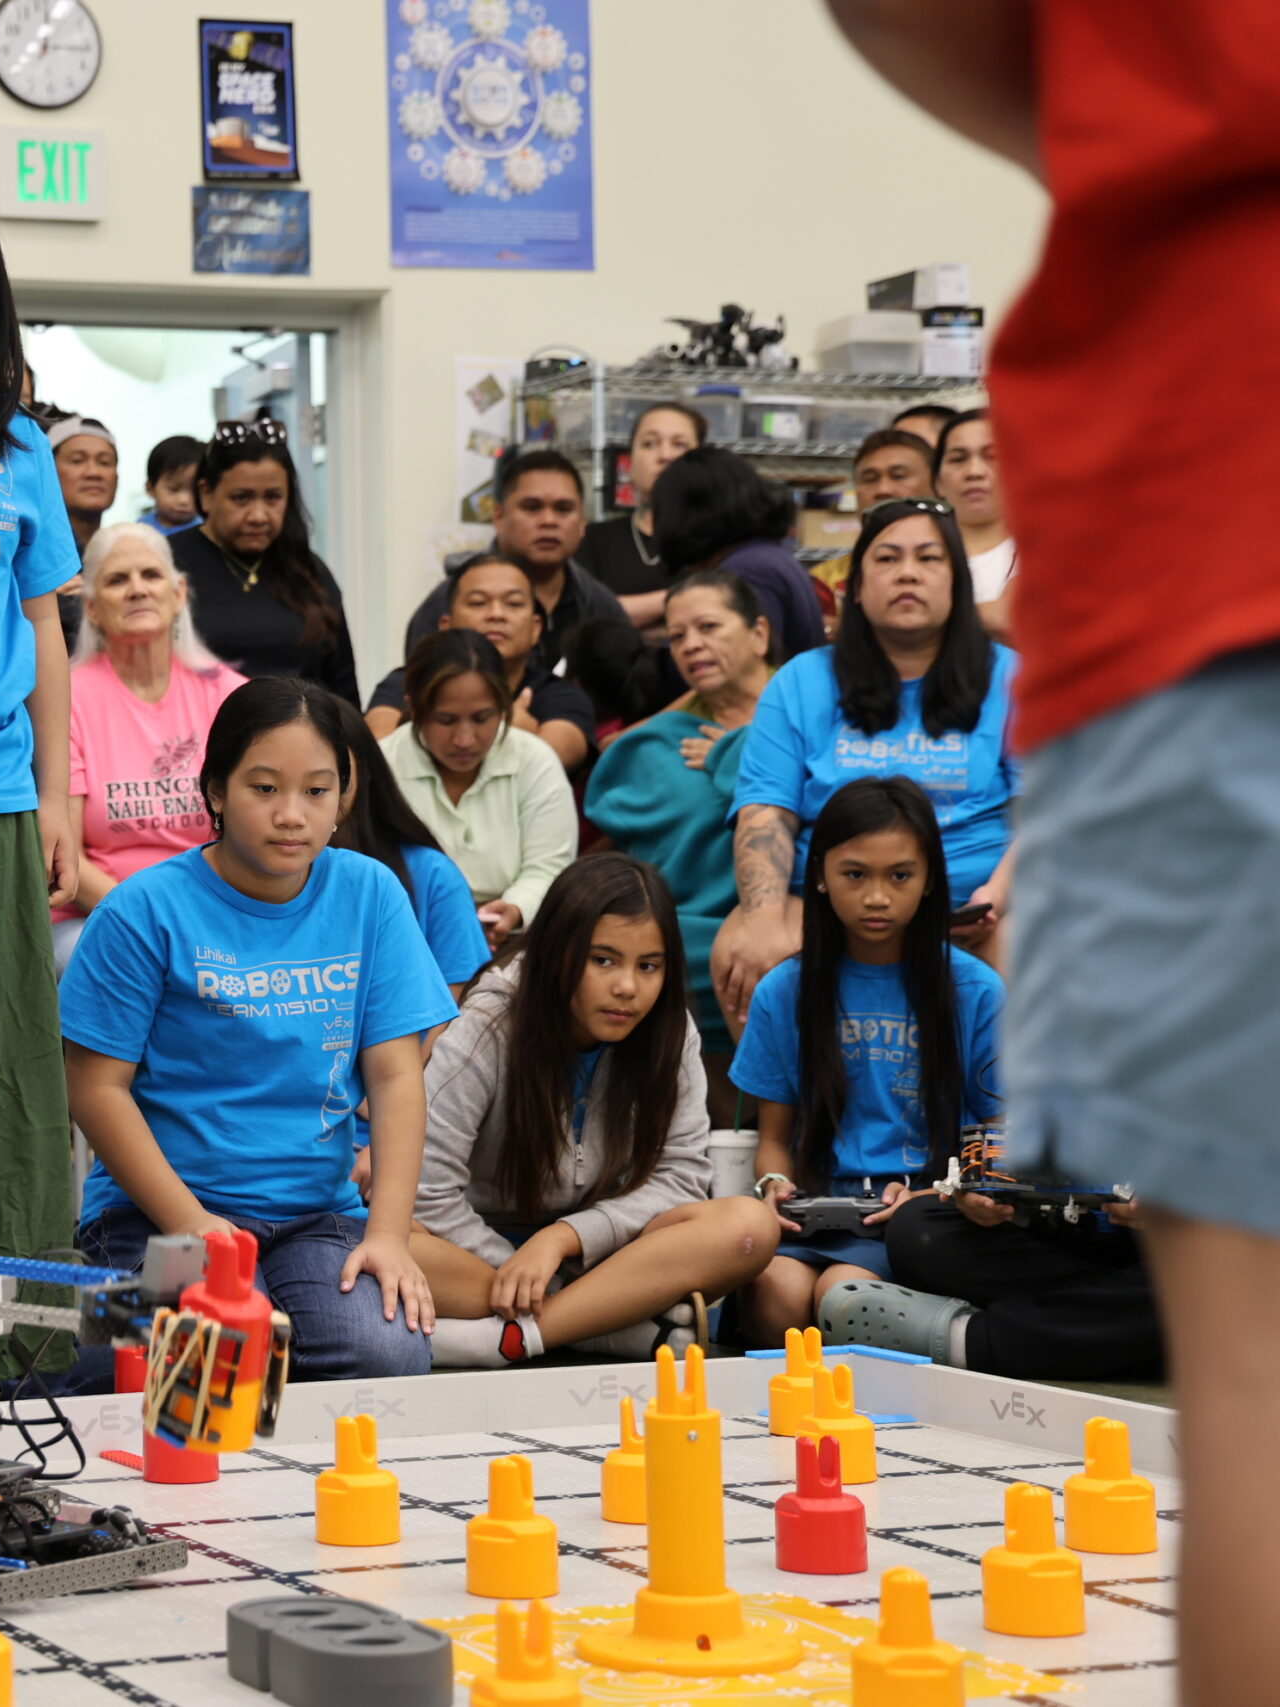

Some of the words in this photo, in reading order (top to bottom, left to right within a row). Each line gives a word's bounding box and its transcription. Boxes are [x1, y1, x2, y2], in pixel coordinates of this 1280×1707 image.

[17, 140, 92, 204] EXIT
[106, 800, 154, 820] NAHI
[136, 814, 205, 831] SCHOO
[196, 946, 237, 965] Lihikai
[203, 1001, 270, 1018] TEAM
[274, 999, 329, 1016] 11510
[567, 1374, 649, 1408] VEX
[990, 1391, 1047, 1429] VEX
